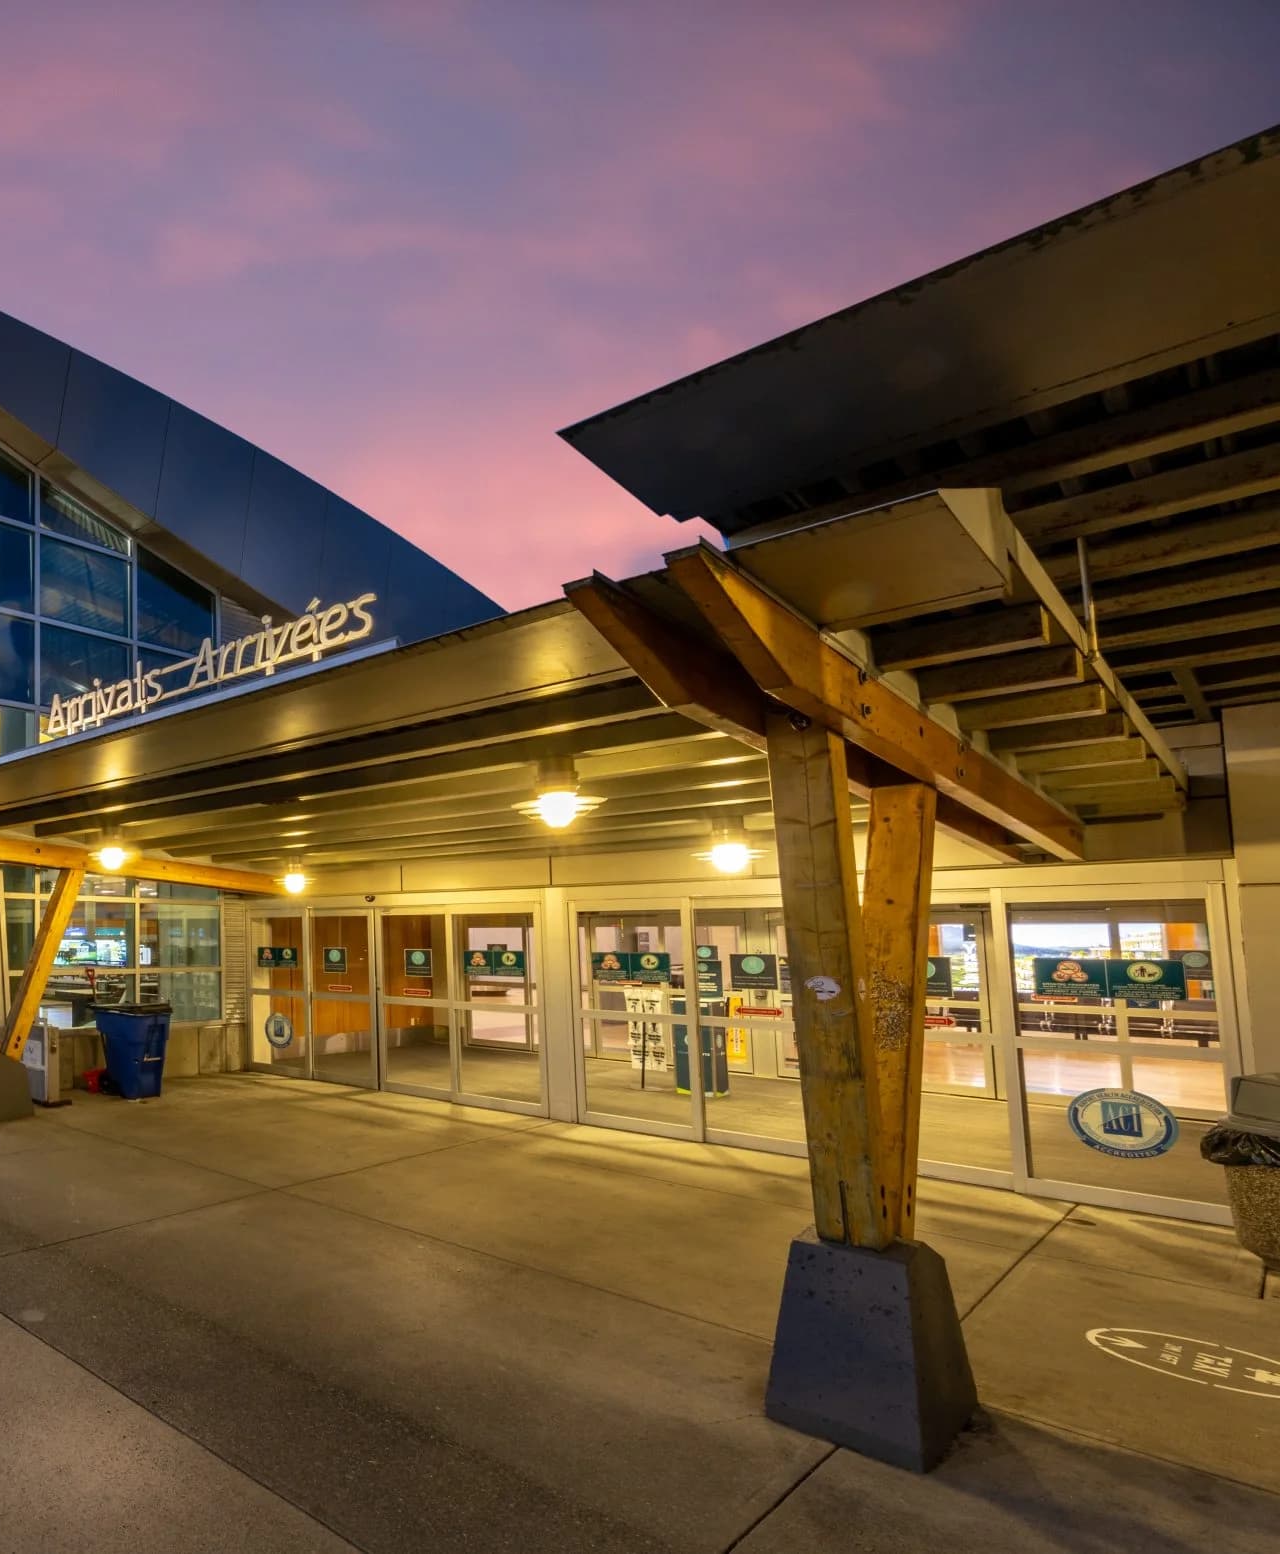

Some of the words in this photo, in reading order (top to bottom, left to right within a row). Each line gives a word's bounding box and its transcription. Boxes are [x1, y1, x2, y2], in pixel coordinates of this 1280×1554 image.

[47, 660, 163, 734] Arrivals
[188, 593, 376, 689] Arrivées
[1105, 1103, 1140, 1133] ACI
[1093, 1144, 1158, 1158] ACCREDITED
